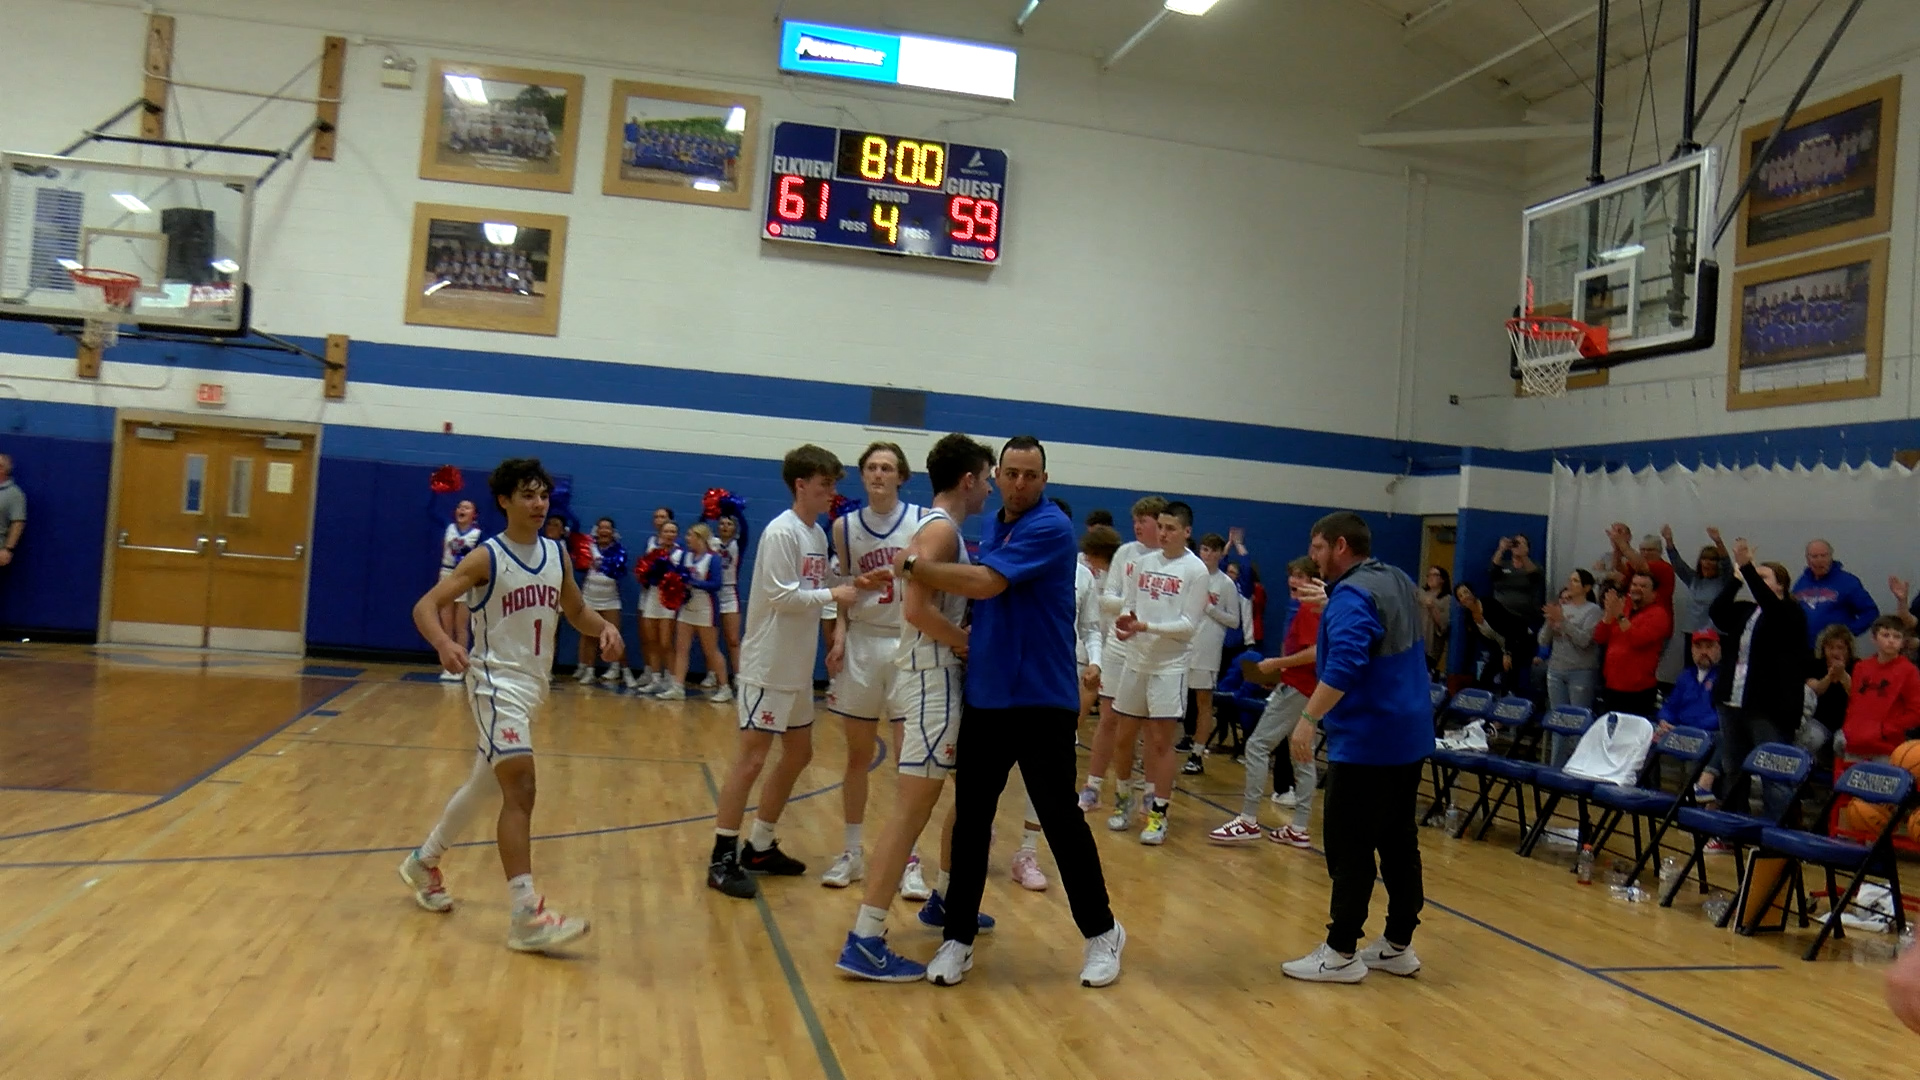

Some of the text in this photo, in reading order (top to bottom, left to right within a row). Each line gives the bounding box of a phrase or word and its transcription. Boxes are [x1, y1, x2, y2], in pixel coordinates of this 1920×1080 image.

[773, 155, 834, 180] ELKVIEW
[860, 135, 945, 188] 8:00
[778, 175, 830, 220] 61
[867, 187, 910, 204] PERIOD
[946, 177, 1002, 200] GUEST
[782, 223, 817, 239] BONUS
[839, 219, 867, 233] POSS
[873, 204, 899, 244] 4
[951, 196, 999, 242] 59
[903, 227, 931, 240] POSS
[951, 244, 985, 260] BONUS
[534, 619, 542, 656] 1
